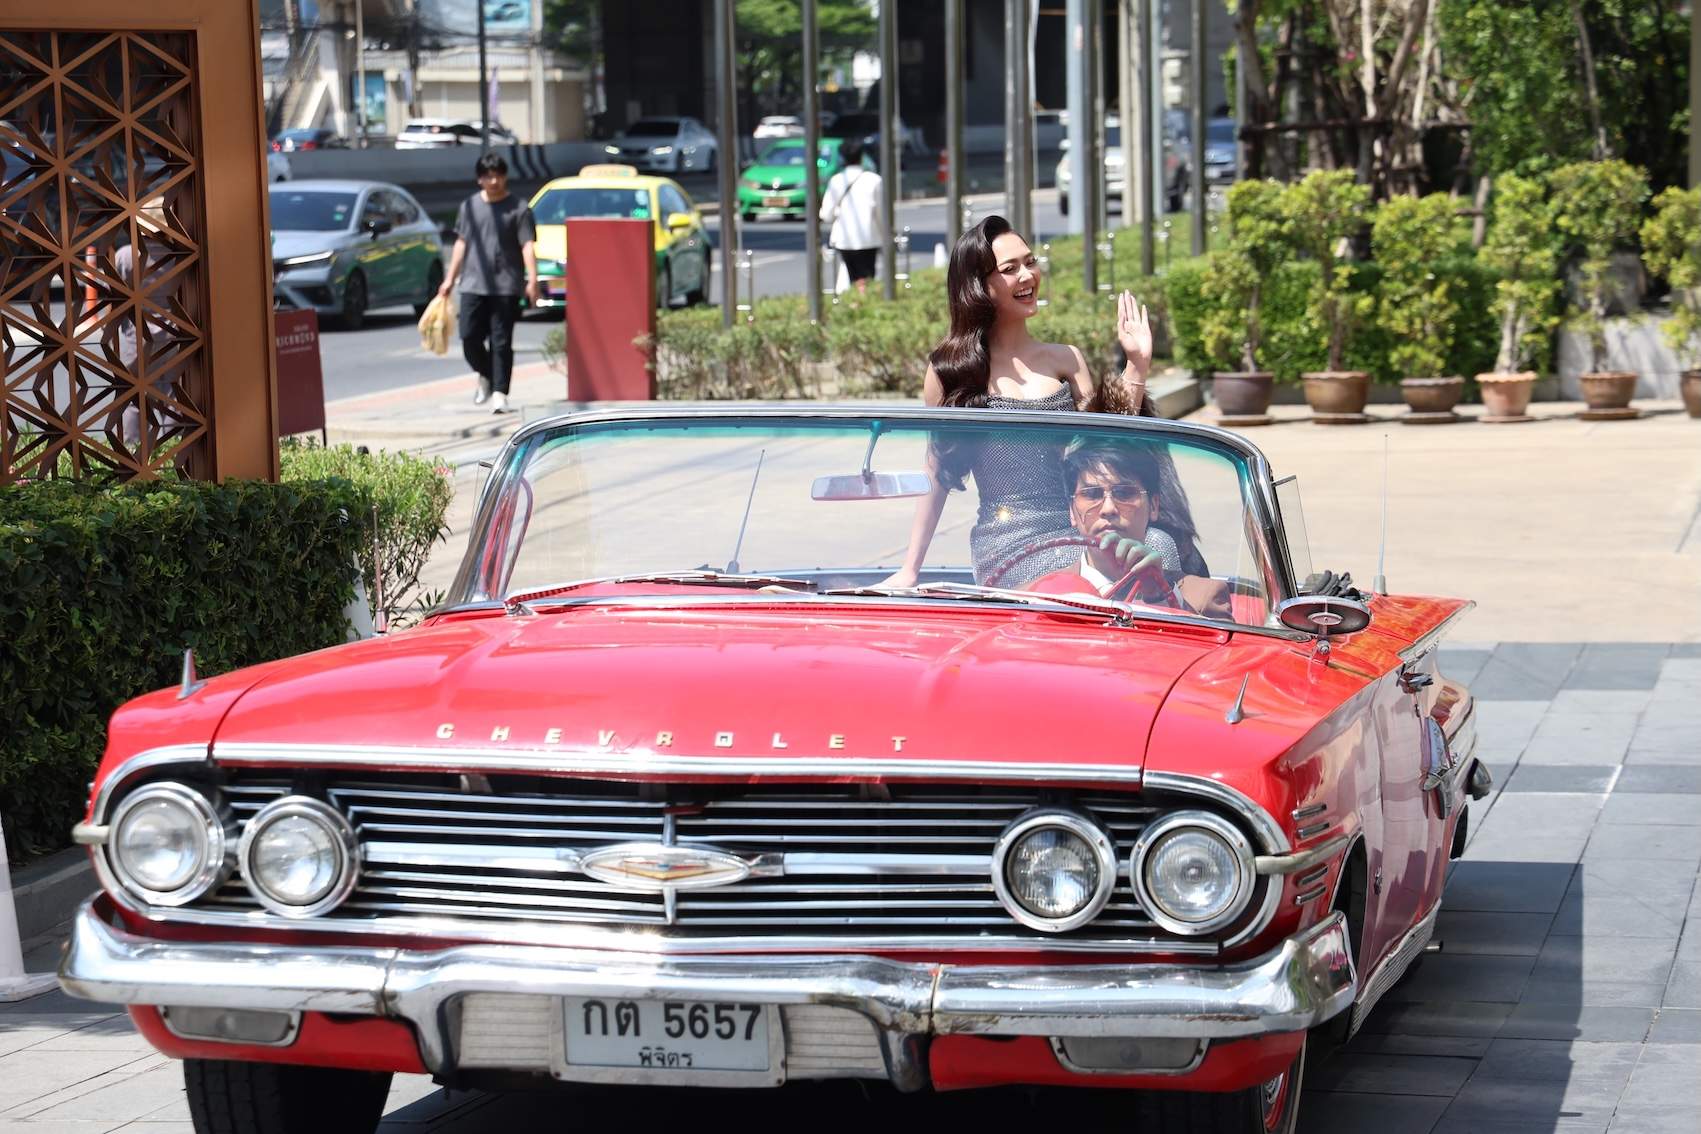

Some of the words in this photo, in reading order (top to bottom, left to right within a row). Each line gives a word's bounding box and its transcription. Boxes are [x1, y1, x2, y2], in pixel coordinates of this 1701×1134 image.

[436, 723, 907, 752] CHEVROLET
[582, 999, 641, 1037] กต
[663, 1003, 761, 1041] 5657
[638, 1046, 693, 1066] พิจิตร
